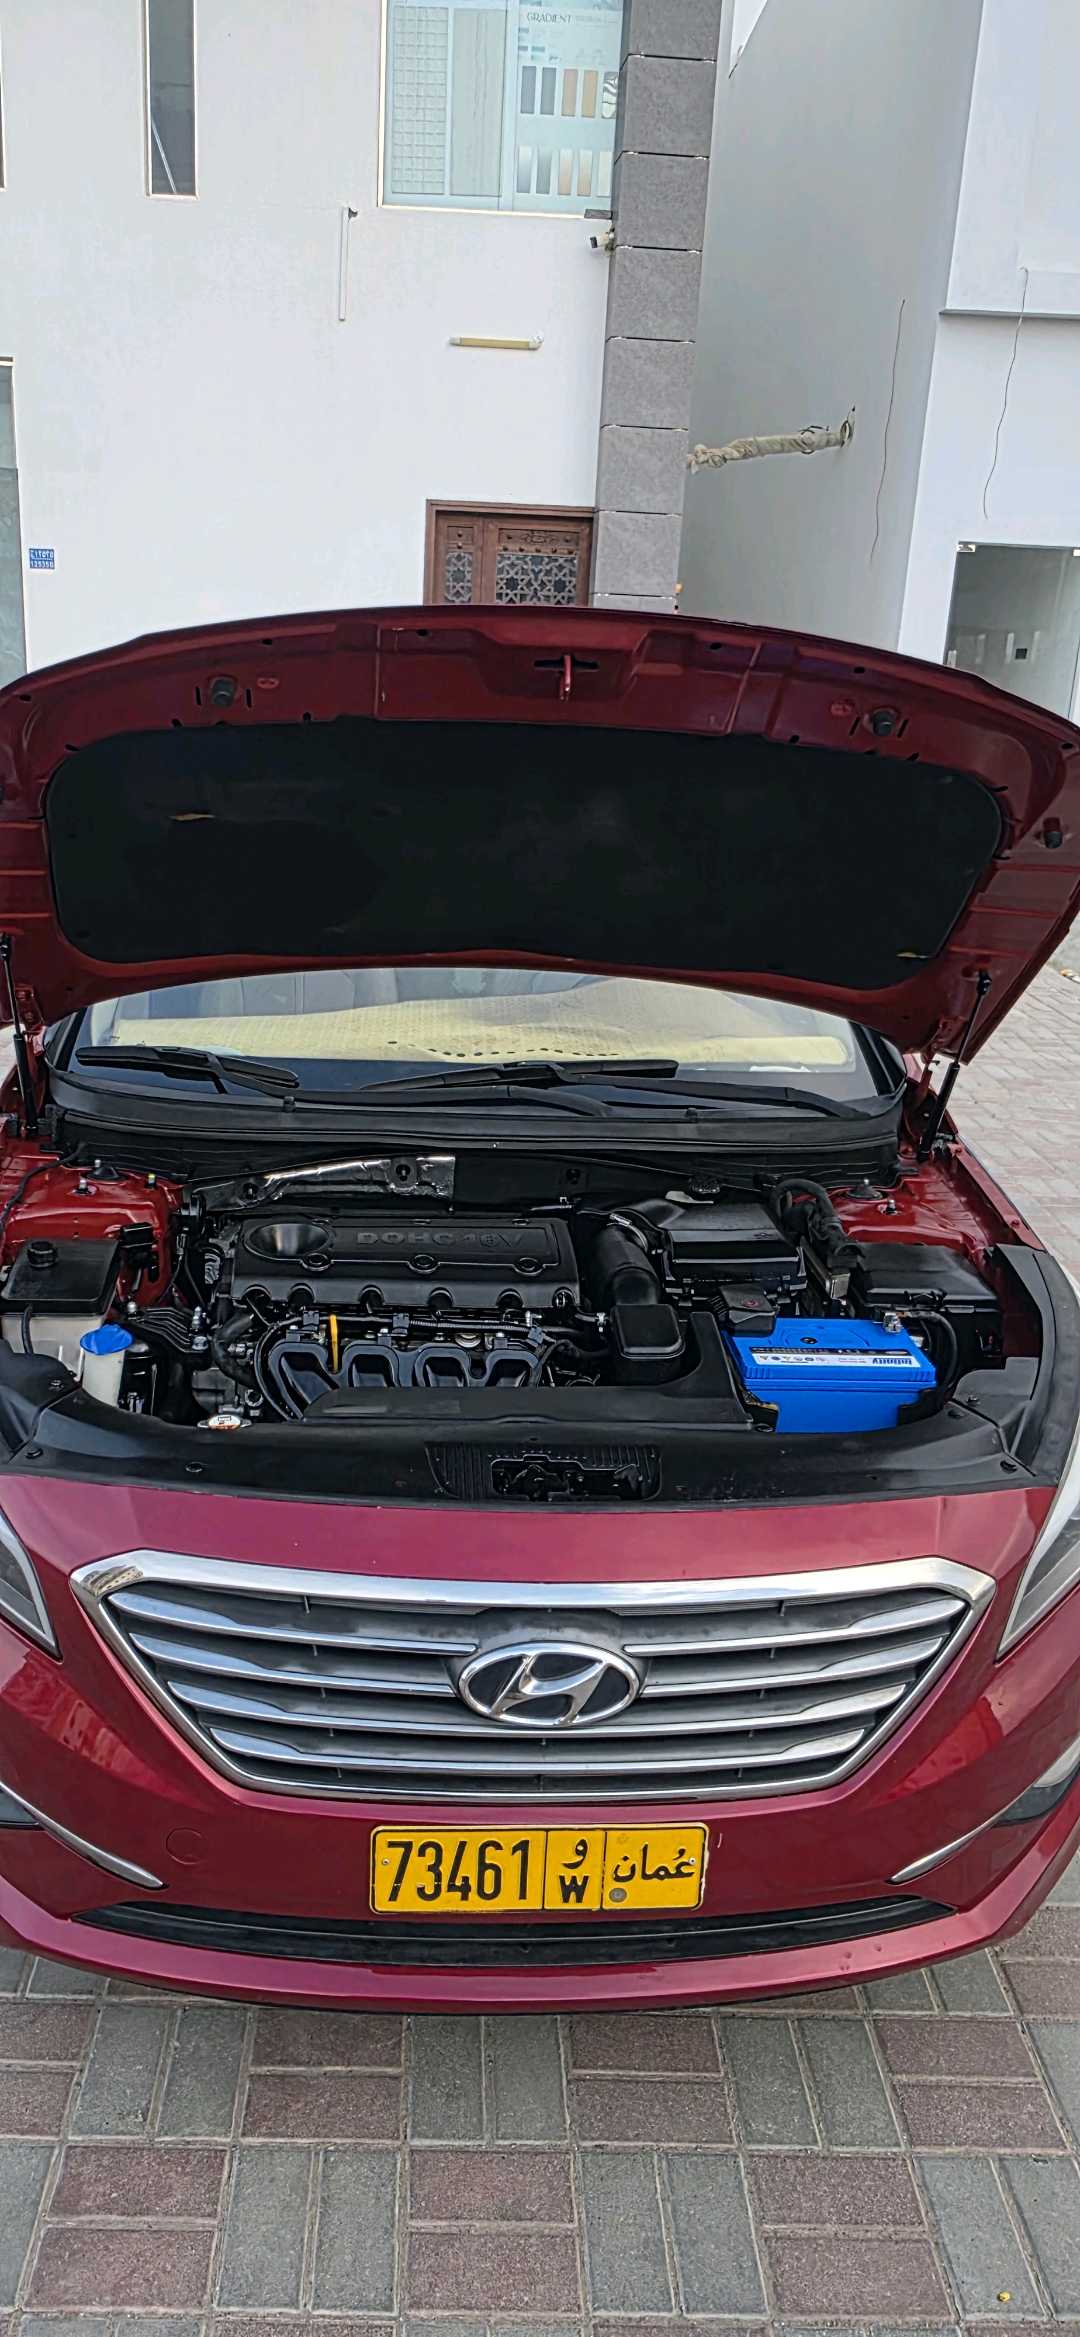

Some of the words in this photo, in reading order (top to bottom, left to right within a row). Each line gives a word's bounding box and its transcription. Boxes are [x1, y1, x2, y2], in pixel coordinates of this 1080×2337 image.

[526, 12, 573, 23] GRADIENT
[356, 1231, 456, 1245] DOHC
[387, 1839, 533, 1902] 73461
[559, 1875, 590, 1904] W
